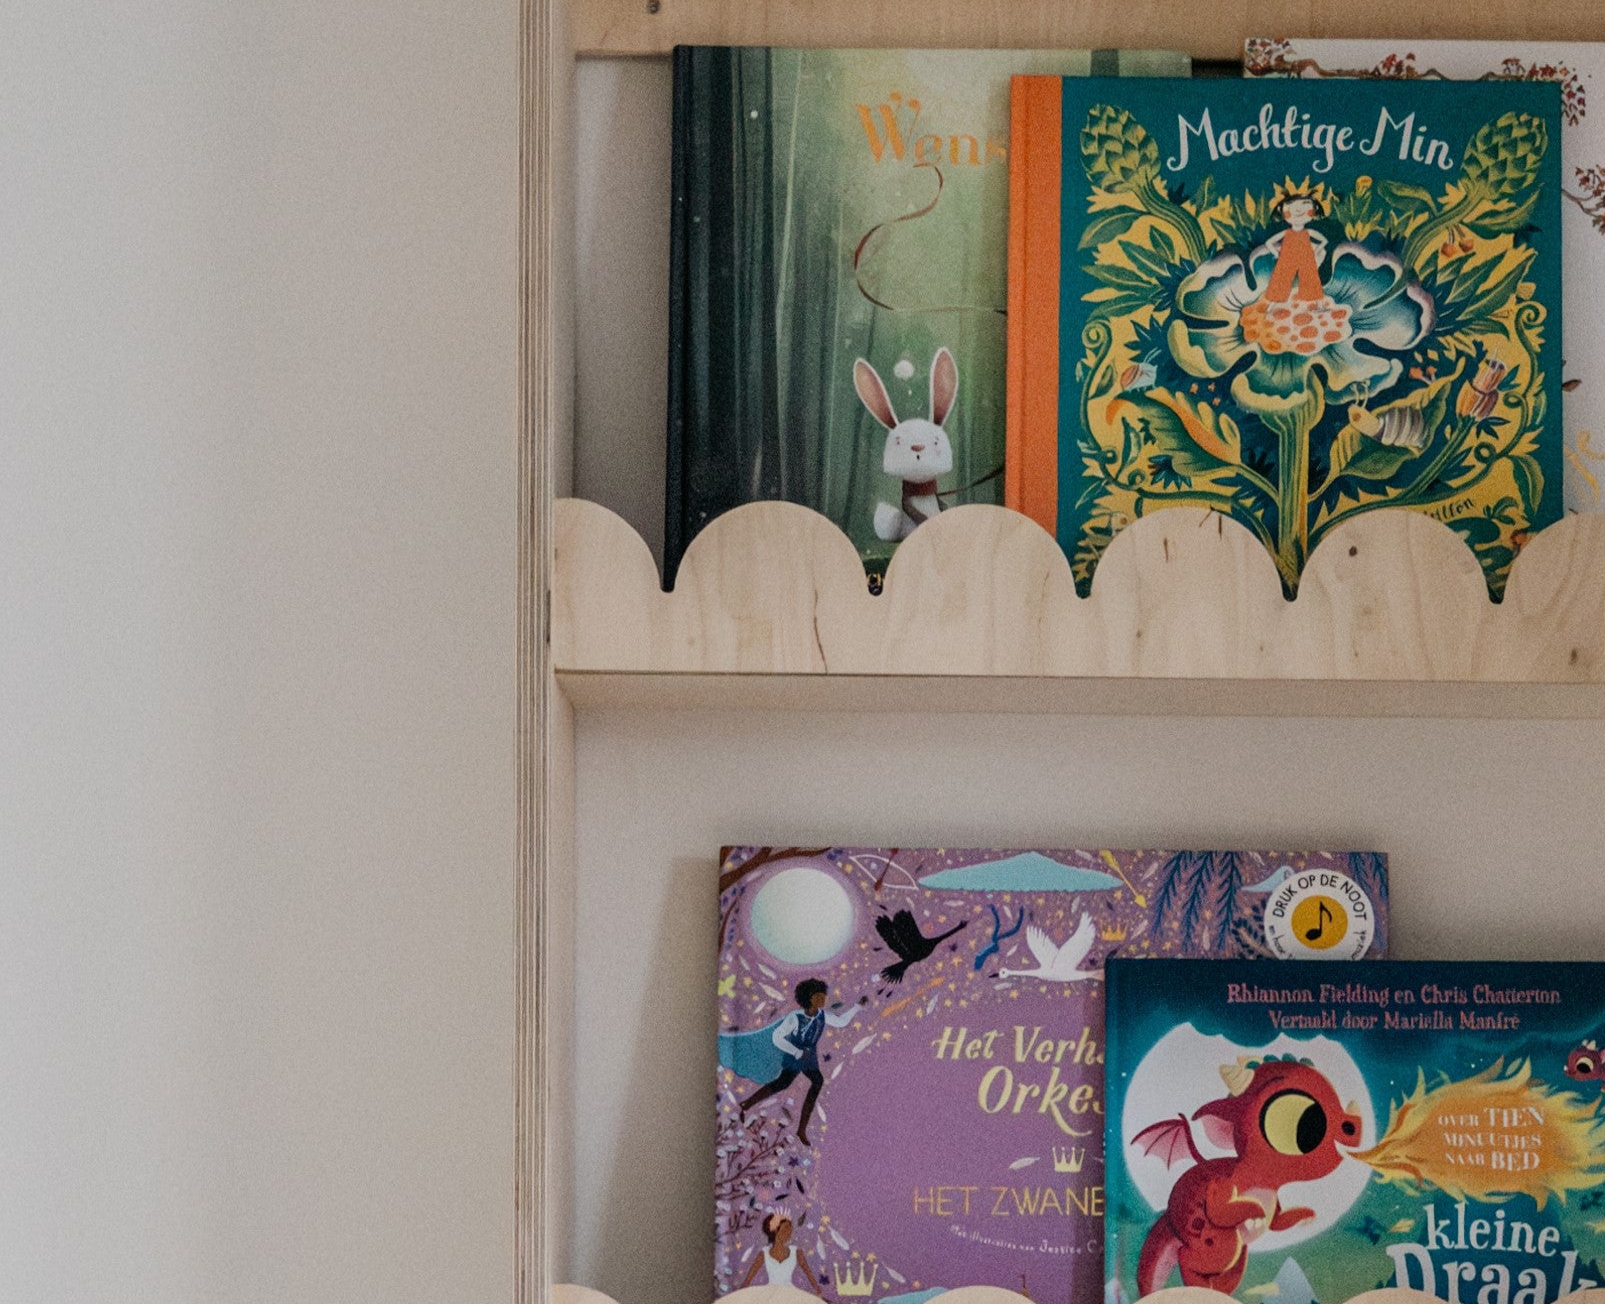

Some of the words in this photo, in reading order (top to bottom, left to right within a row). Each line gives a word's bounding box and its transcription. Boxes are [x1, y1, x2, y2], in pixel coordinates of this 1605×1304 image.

[1166, 102, 1355, 174] Machtige
[1358, 105, 1454, 171] Min
[1272, 884, 1298, 918] DRUK
[1297, 874, 1317, 890] OP
[1319, 873, 1339, 888] DE
[1340, 880, 1367, 921] NOOT
[1227, 983, 1315, 1004] Rhiannon
[1319, 983, 1391, 1008] Fielding
[1394, 988, 1416, 1004] en
[1420, 983, 1469, 1005] Chris
[1473, 983, 1563, 1005] Chatterton
[1268, 1009, 1338, 1030] Vertaald
[1341, 1010, 1379, 1030] door
[931, 1025, 1005, 1060] Het
[1437, 1114, 1479, 1127] OVER
[1483, 1106, 1544, 1128] TIEN
[1490, 1150, 1541, 1172] BED
[912, 1185, 980, 1217] HET
[1423, 1201, 1561, 1258] kleine
